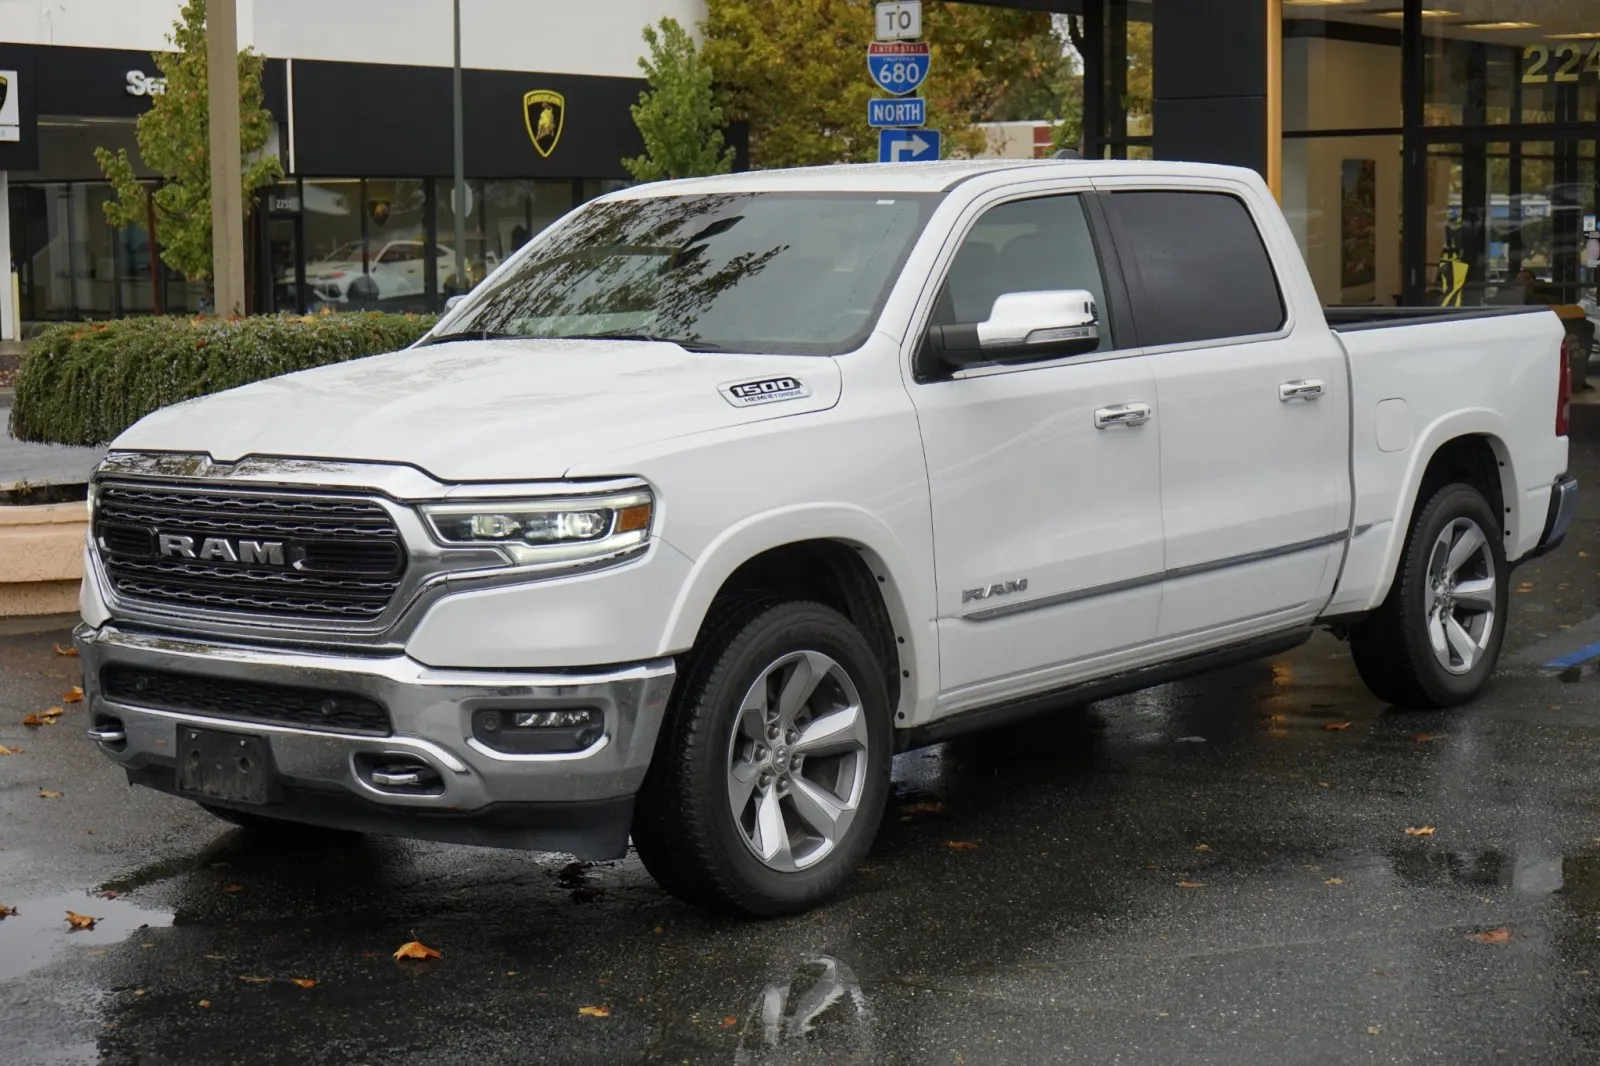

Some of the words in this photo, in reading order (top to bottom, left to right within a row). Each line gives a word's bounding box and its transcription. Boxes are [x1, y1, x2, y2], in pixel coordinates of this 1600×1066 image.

[885, 10, 911, 31] TO
[874, 45, 924, 53] INTERSTATE
[879, 63, 919, 84] 680
[874, 104, 920, 122] NORTH
[732, 379, 795, 396] 1500
[744, 394, 768, 403] HEMI
[159, 533, 285, 565] RAM
[962, 577, 1028, 604] RAM
